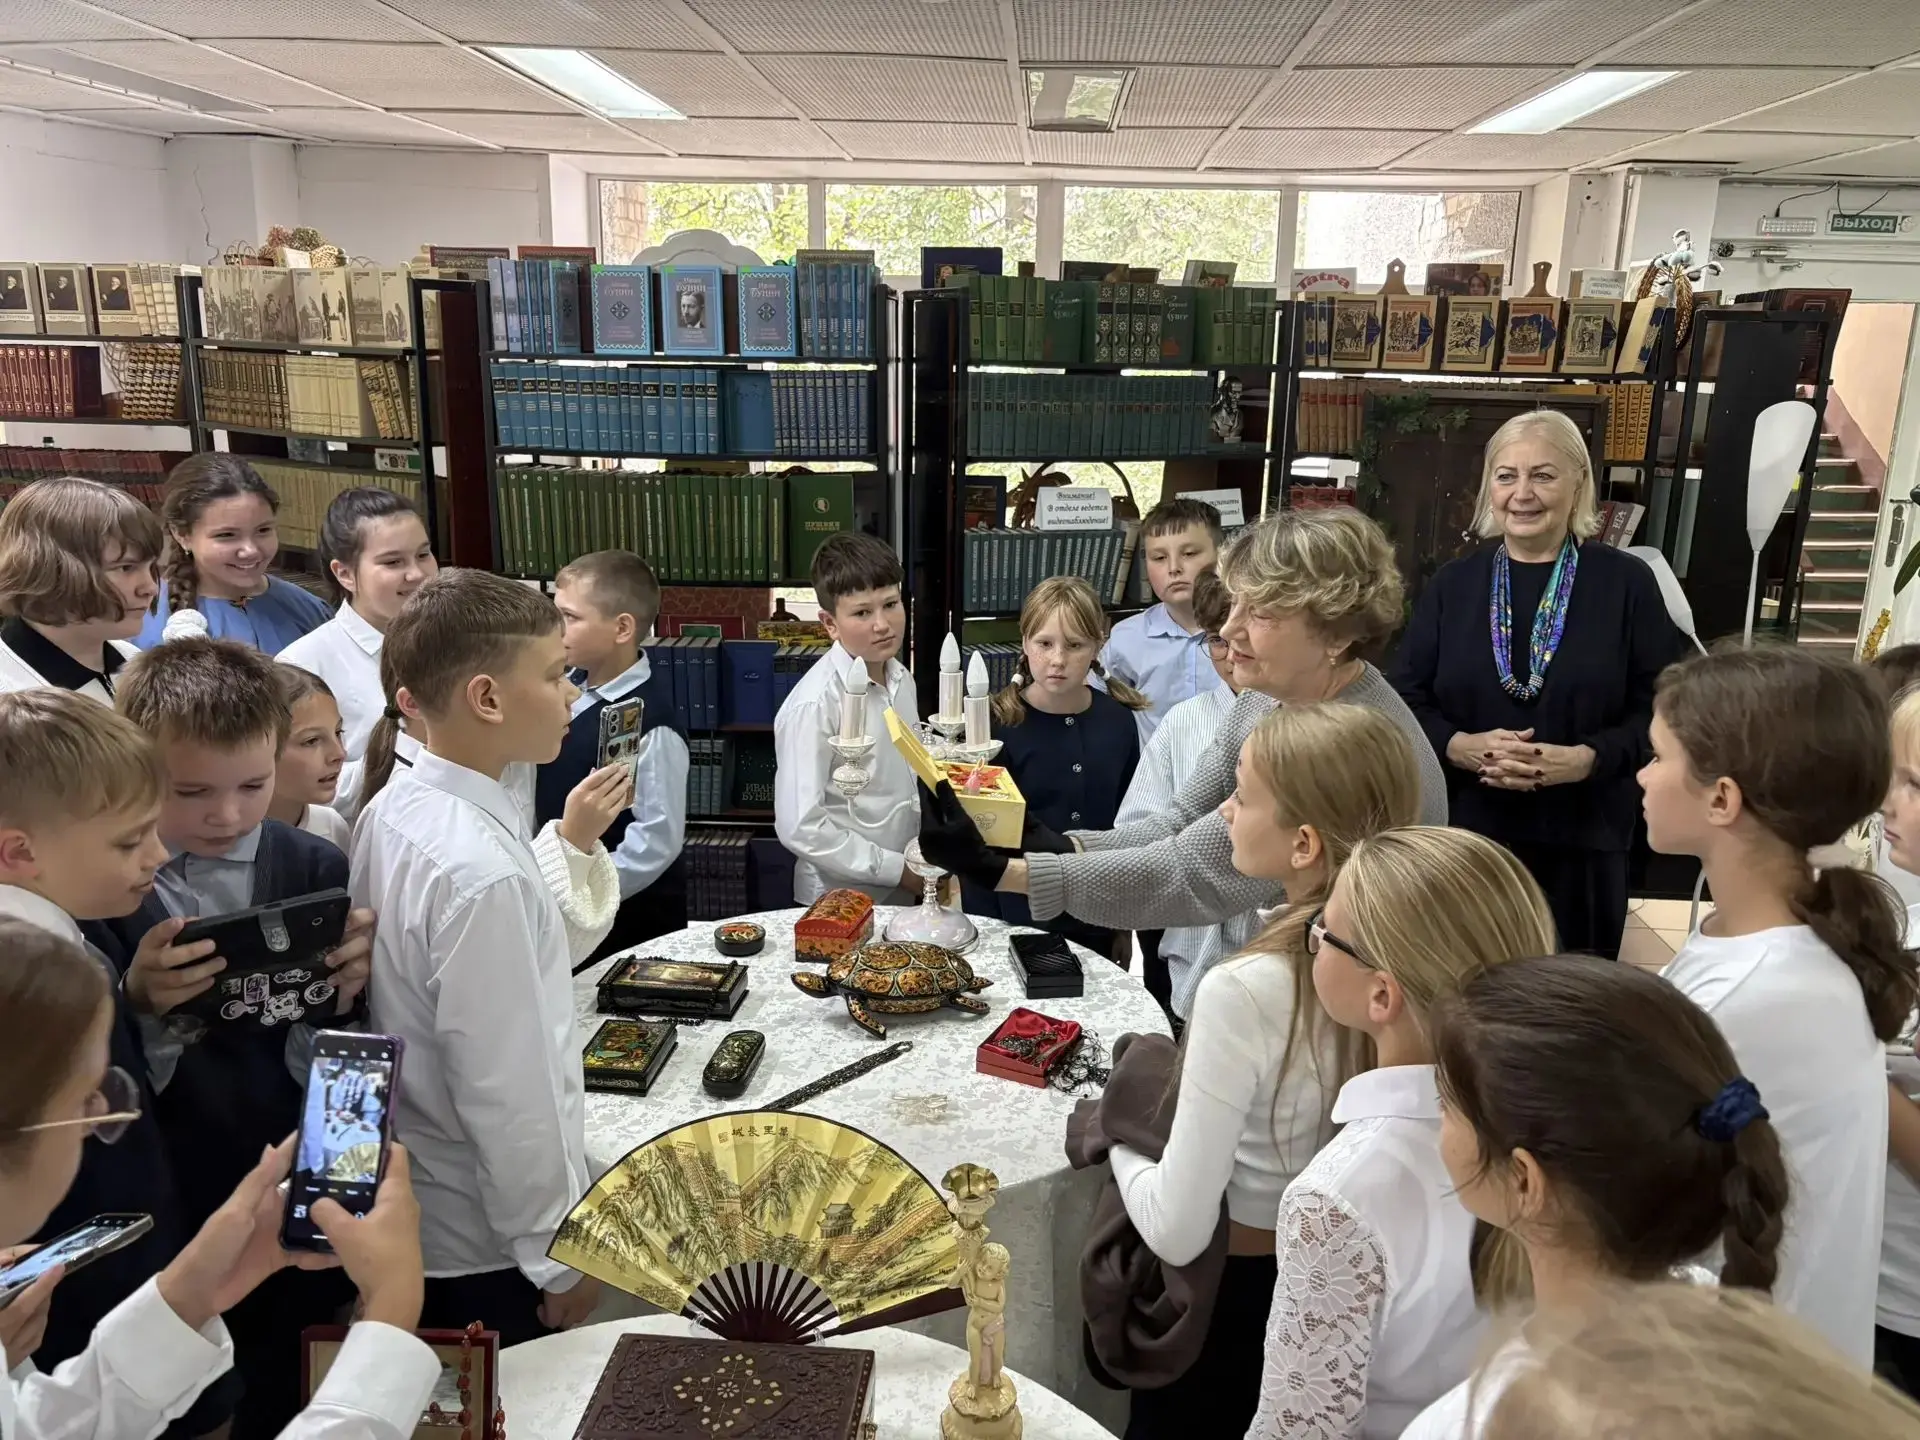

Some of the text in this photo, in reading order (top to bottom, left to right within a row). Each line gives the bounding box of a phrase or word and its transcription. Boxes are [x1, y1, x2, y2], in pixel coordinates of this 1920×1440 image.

[1833, 217, 1895, 231] ВЫХОД
[1615, 388, 1626, 446] СЕРВАНТЕС
[1627, 388, 1640, 446] СЕРВАНТЕС
[1638, 388, 1653, 446] СЕРВАНТЕС
[1056, 491, 1096, 500] Внимание!
[1047, 503, 1109, 512] В отделе ведется
[1047, 515, 1109, 525] видеонаблюдение!
[745, 783, 775, 792] ИВАН
